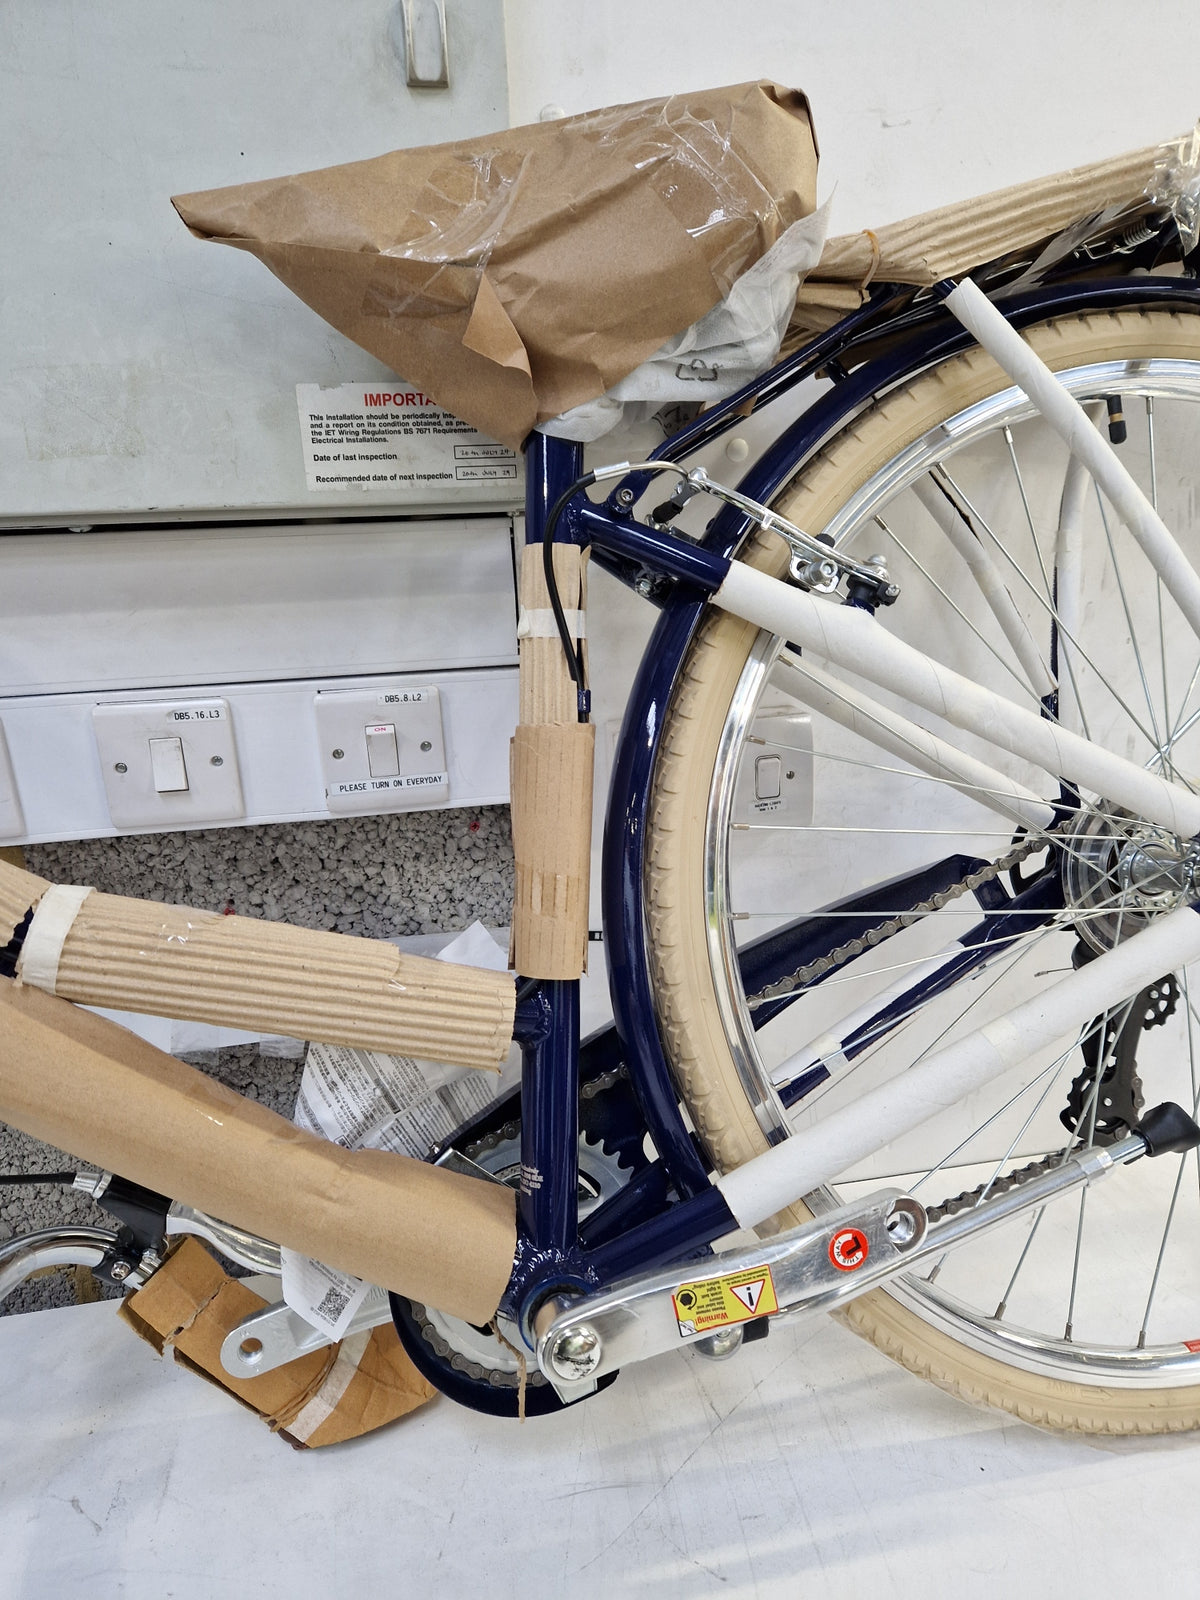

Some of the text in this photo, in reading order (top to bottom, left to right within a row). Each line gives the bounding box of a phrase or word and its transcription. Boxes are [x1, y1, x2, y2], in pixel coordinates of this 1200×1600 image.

[364, 392, 437, 407] IMPORTA
[402, 412, 440, 420] periodically
[362, 428, 401, 436] Regulations
[433, 427, 478, 435] Requirements
[358, 453, 398, 462] inspection
[316, 474, 371, 483] Recommended
[372, 474, 388, 482] date
[416, 472, 453, 481] inspection
[384, 693, 422, 703] DB5.8.L2
[174, 710, 220, 721] DB5.16.L3
[339, 782, 367, 793] PLEASE
[371, 781, 390, 789] TURN
[406, 775, 442, 786] EVERYDAY
[842, 1255, 860, 1264] THIS
[695, 1312, 728, 1326] Warning!
